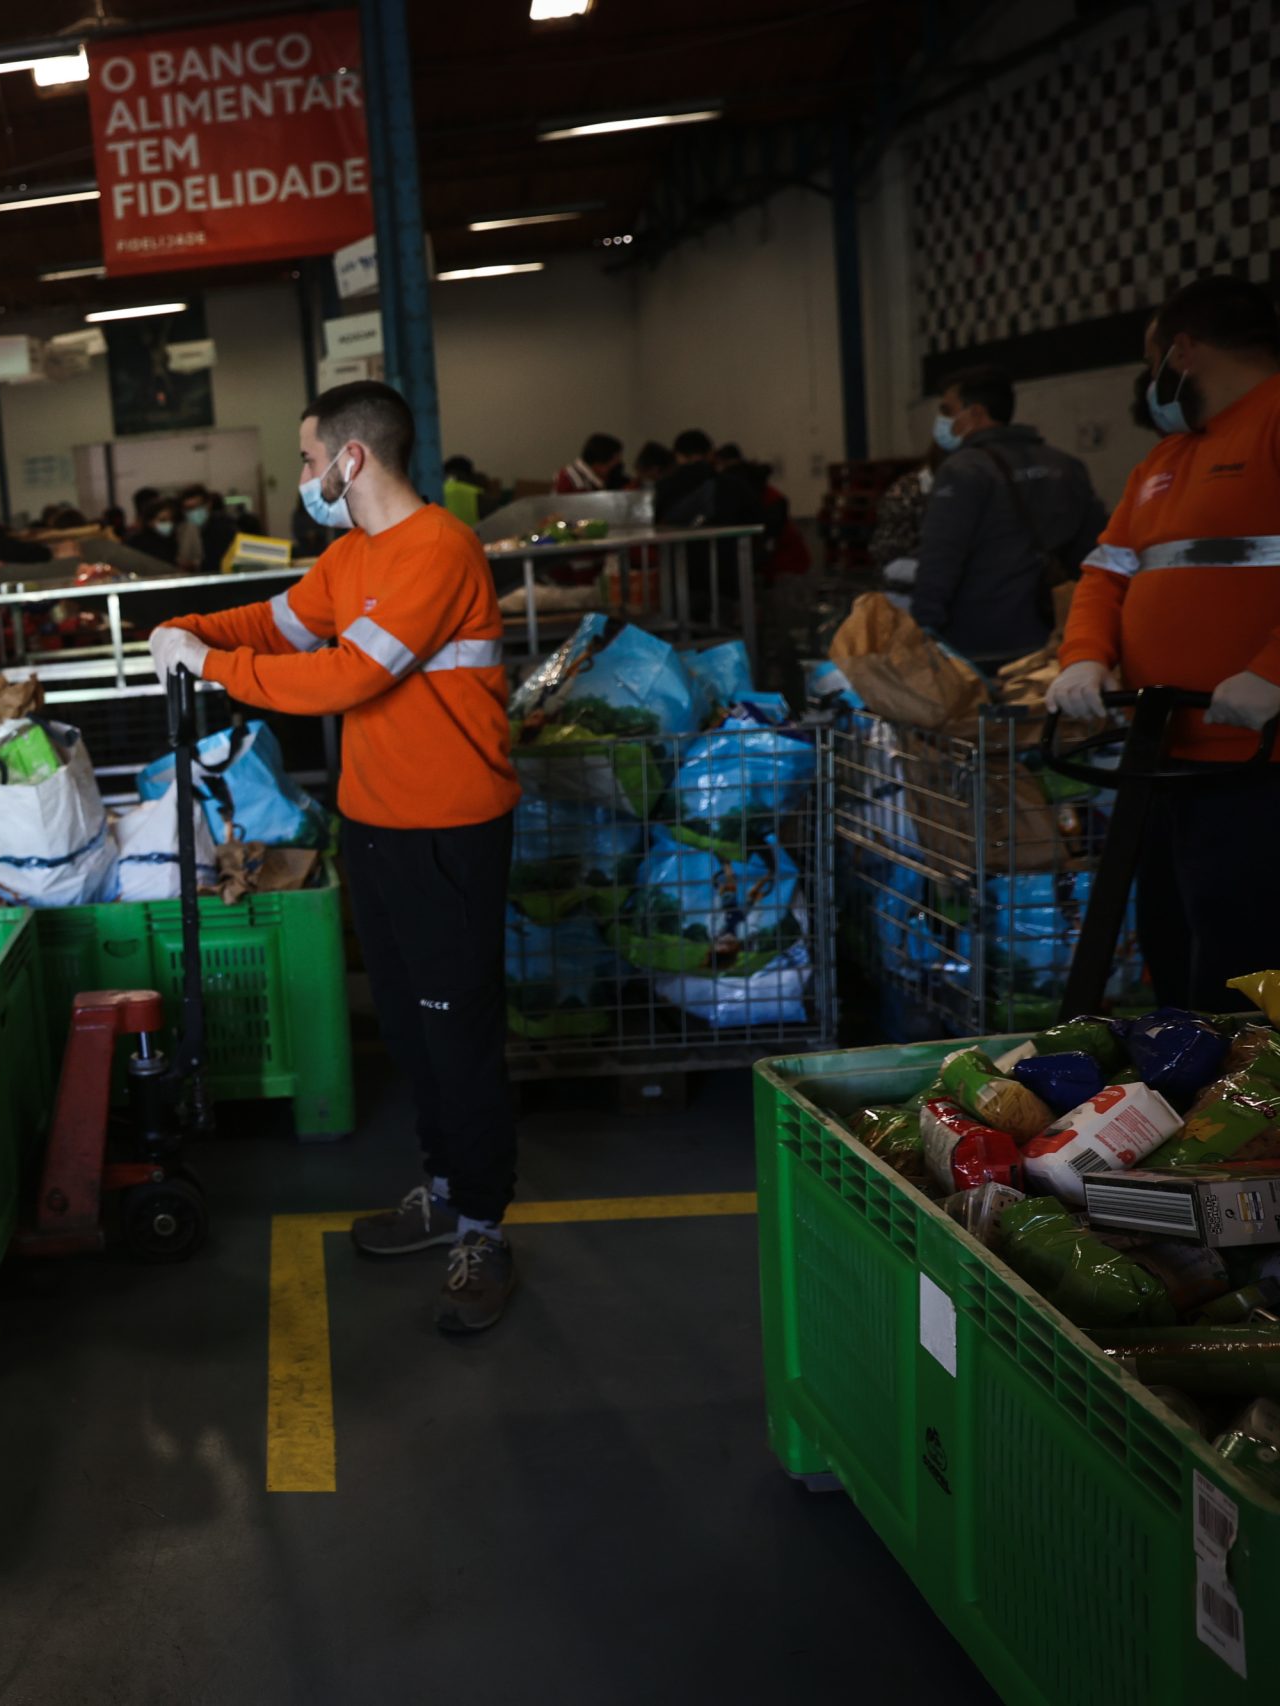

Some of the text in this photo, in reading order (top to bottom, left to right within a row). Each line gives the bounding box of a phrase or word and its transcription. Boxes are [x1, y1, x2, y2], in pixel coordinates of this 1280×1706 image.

[100, 32, 312, 93] O BANCO
[105, 70, 362, 136] ALIMENTAR
[106, 132, 201, 177] TEM
[111, 157, 368, 220] FIDELIDADE
